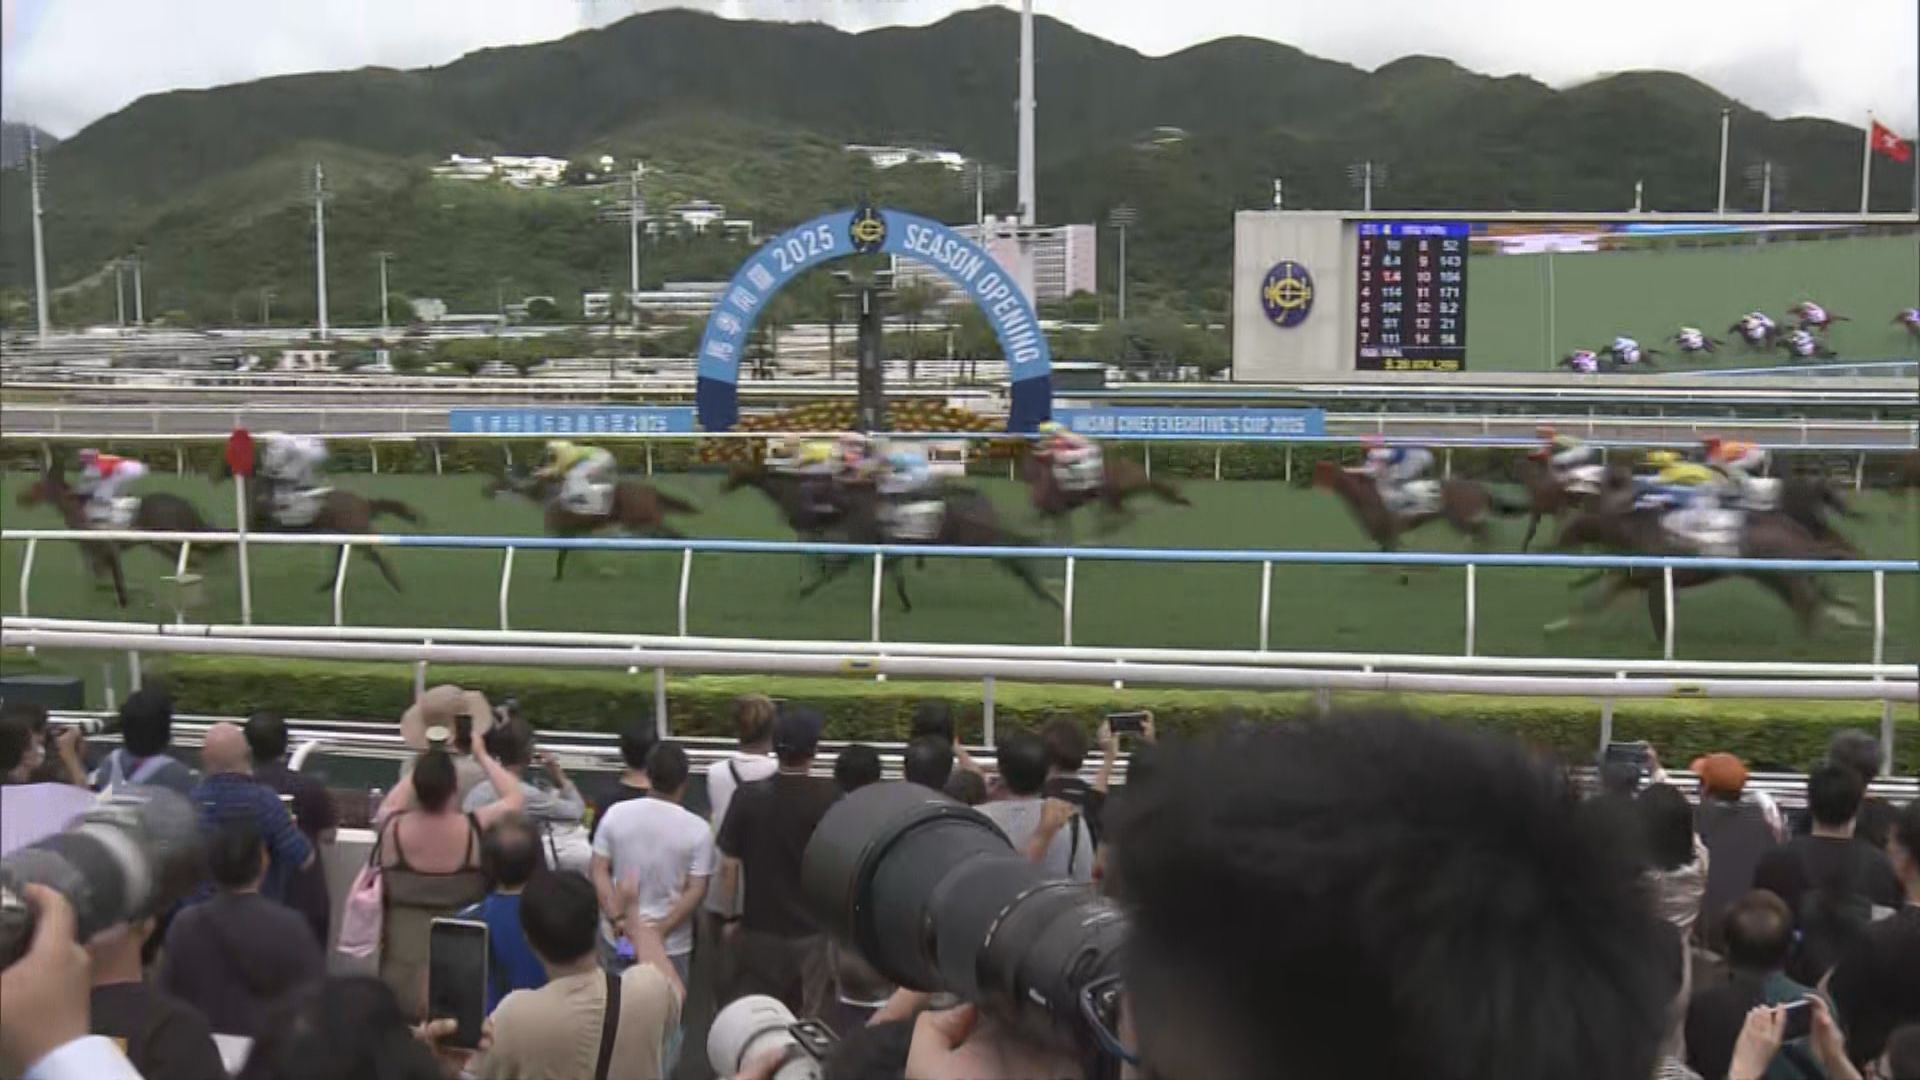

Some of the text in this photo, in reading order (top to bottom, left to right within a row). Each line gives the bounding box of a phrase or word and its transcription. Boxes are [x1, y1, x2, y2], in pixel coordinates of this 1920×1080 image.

[772, 223, 835, 272] 2025
[1362, 240, 1371, 250] 1
[1361, 255, 1371, 266] 2
[1361, 271, 1371, 281] 3
[903, 223, 1041, 364] SEASON OPENING
[1361, 287, 1371, 297] 4
[1416, 287, 1429, 297] 11
[1360, 333, 1369, 343] 7
[1415, 333, 1430, 343] 14
[1118, 415, 1155, 432] CHIEF
